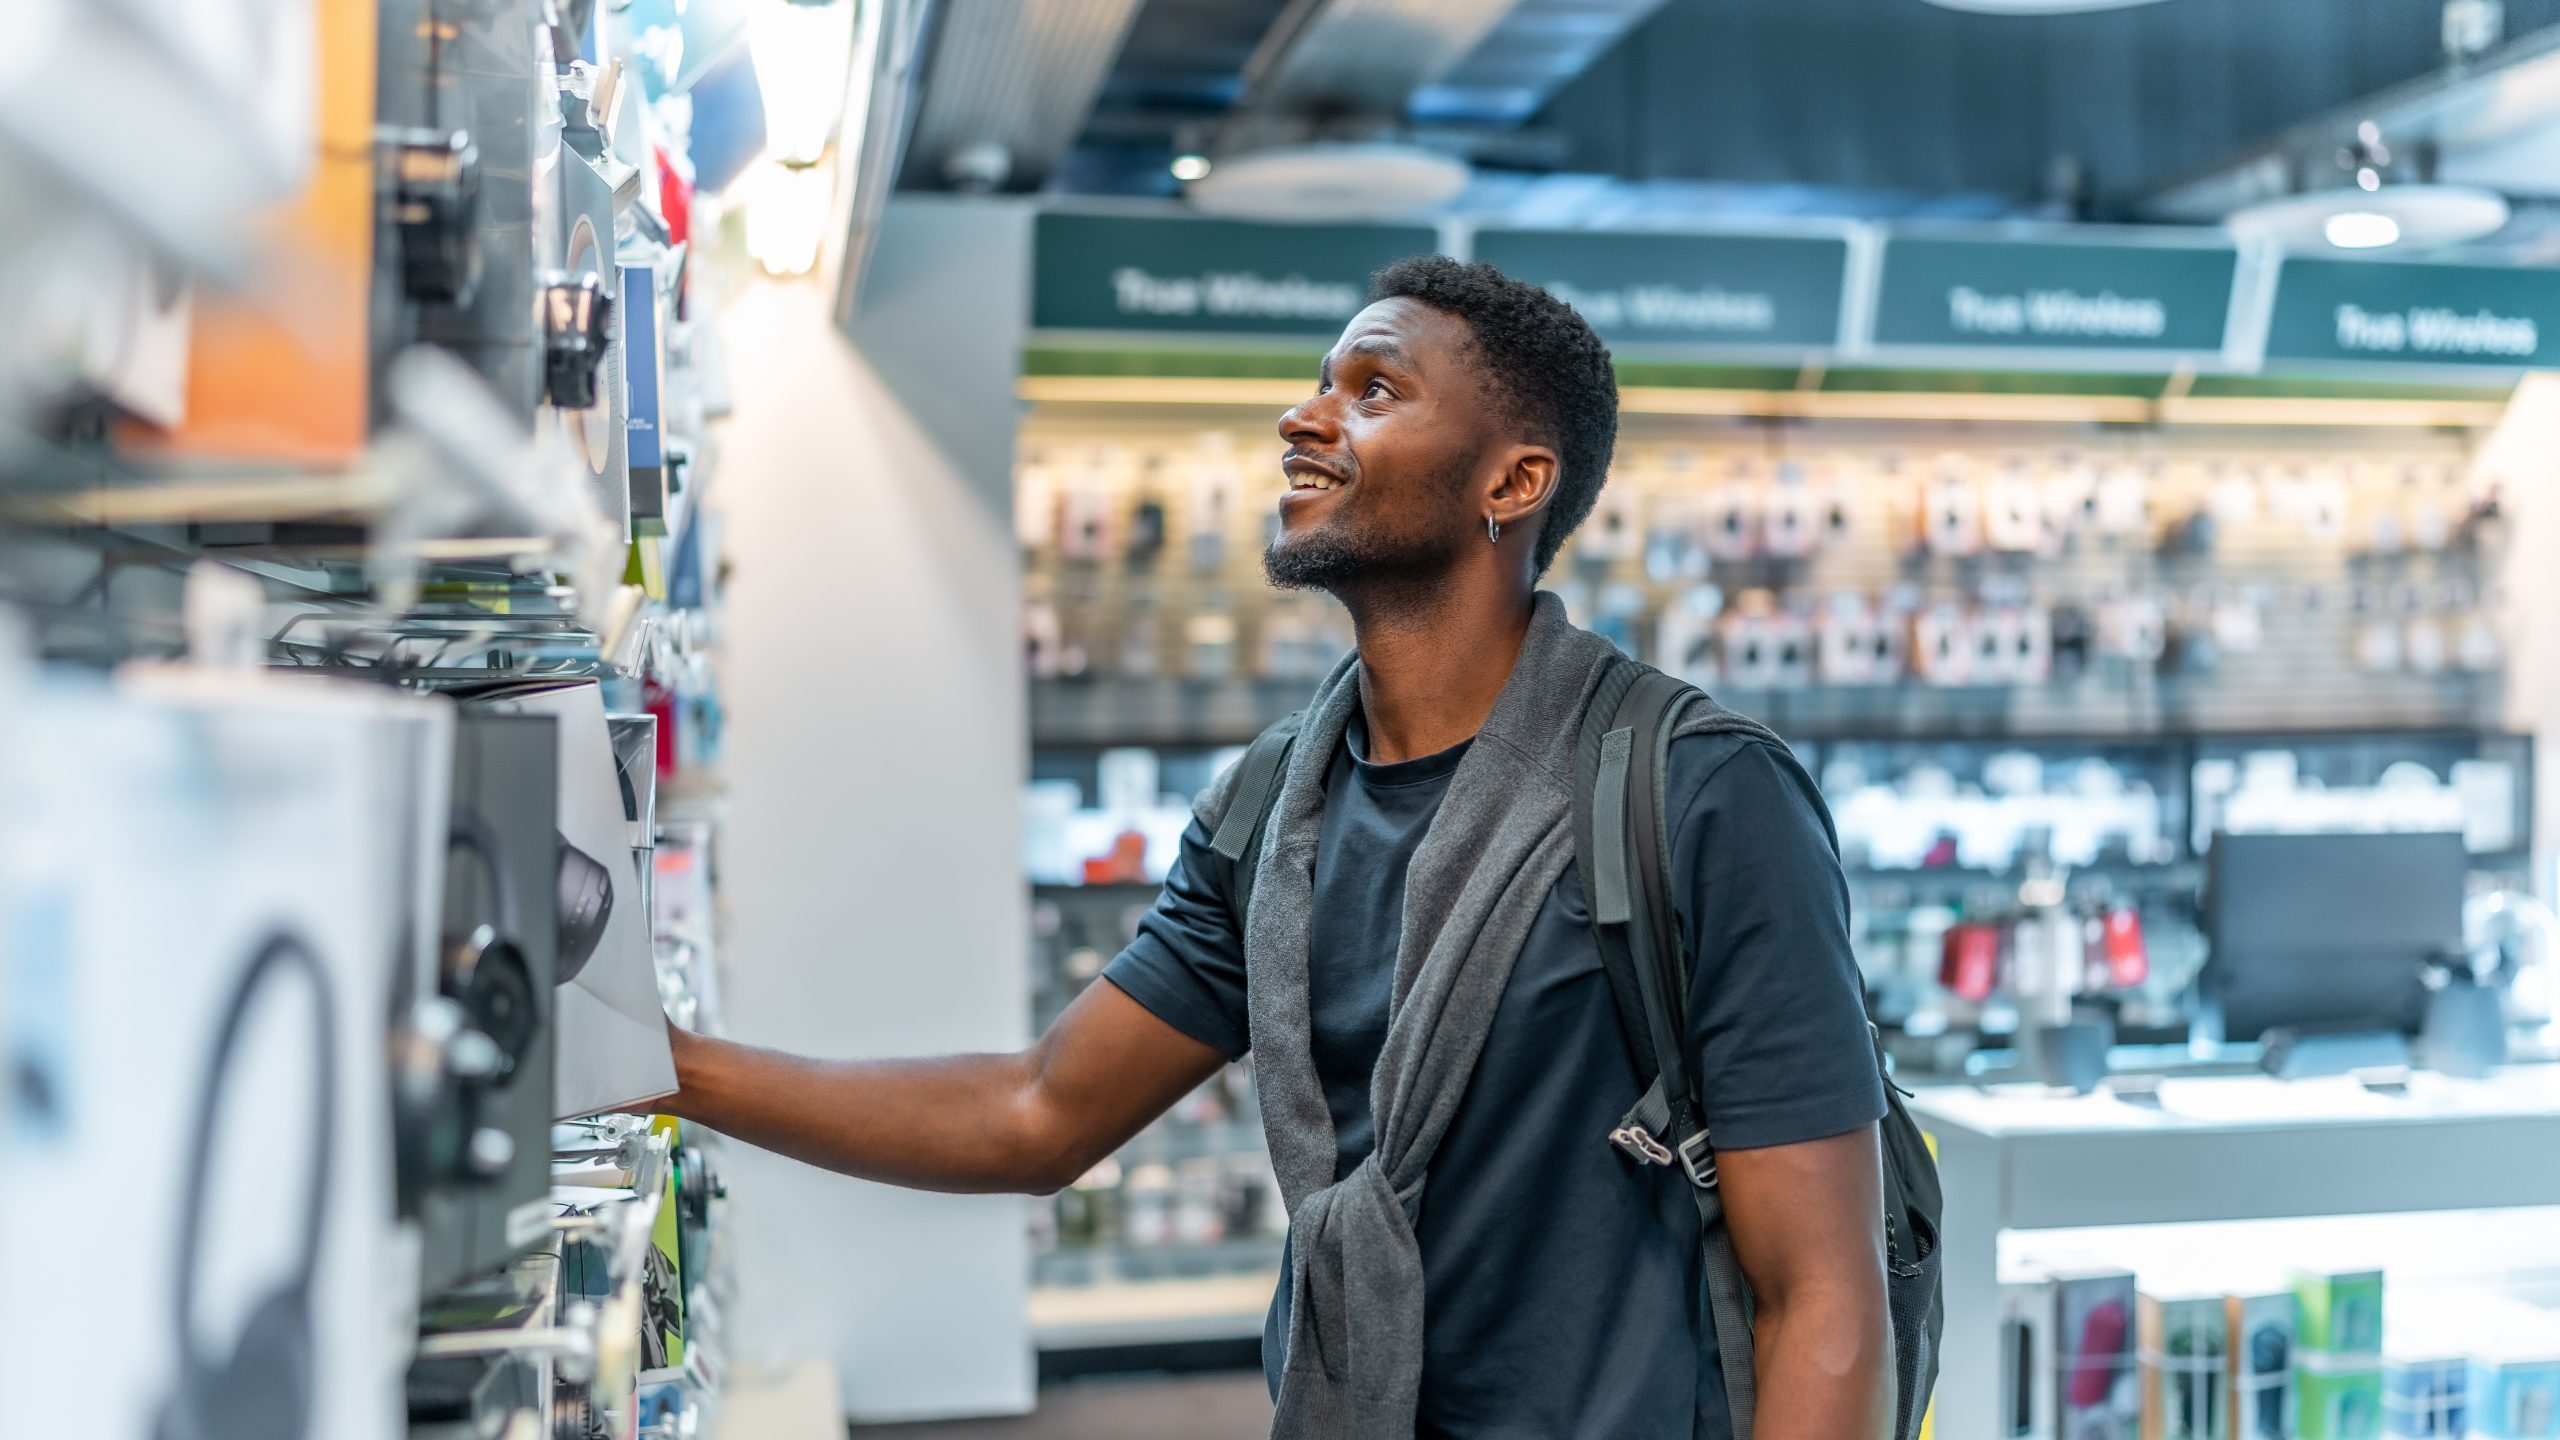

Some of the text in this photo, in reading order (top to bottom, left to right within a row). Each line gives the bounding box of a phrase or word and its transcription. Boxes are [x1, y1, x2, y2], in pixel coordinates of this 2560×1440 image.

[1624, 284, 1775, 331] Wireless
[1949, 286, 2166, 337] True Wireless
[2334, 304, 2538, 355] True Wireless
